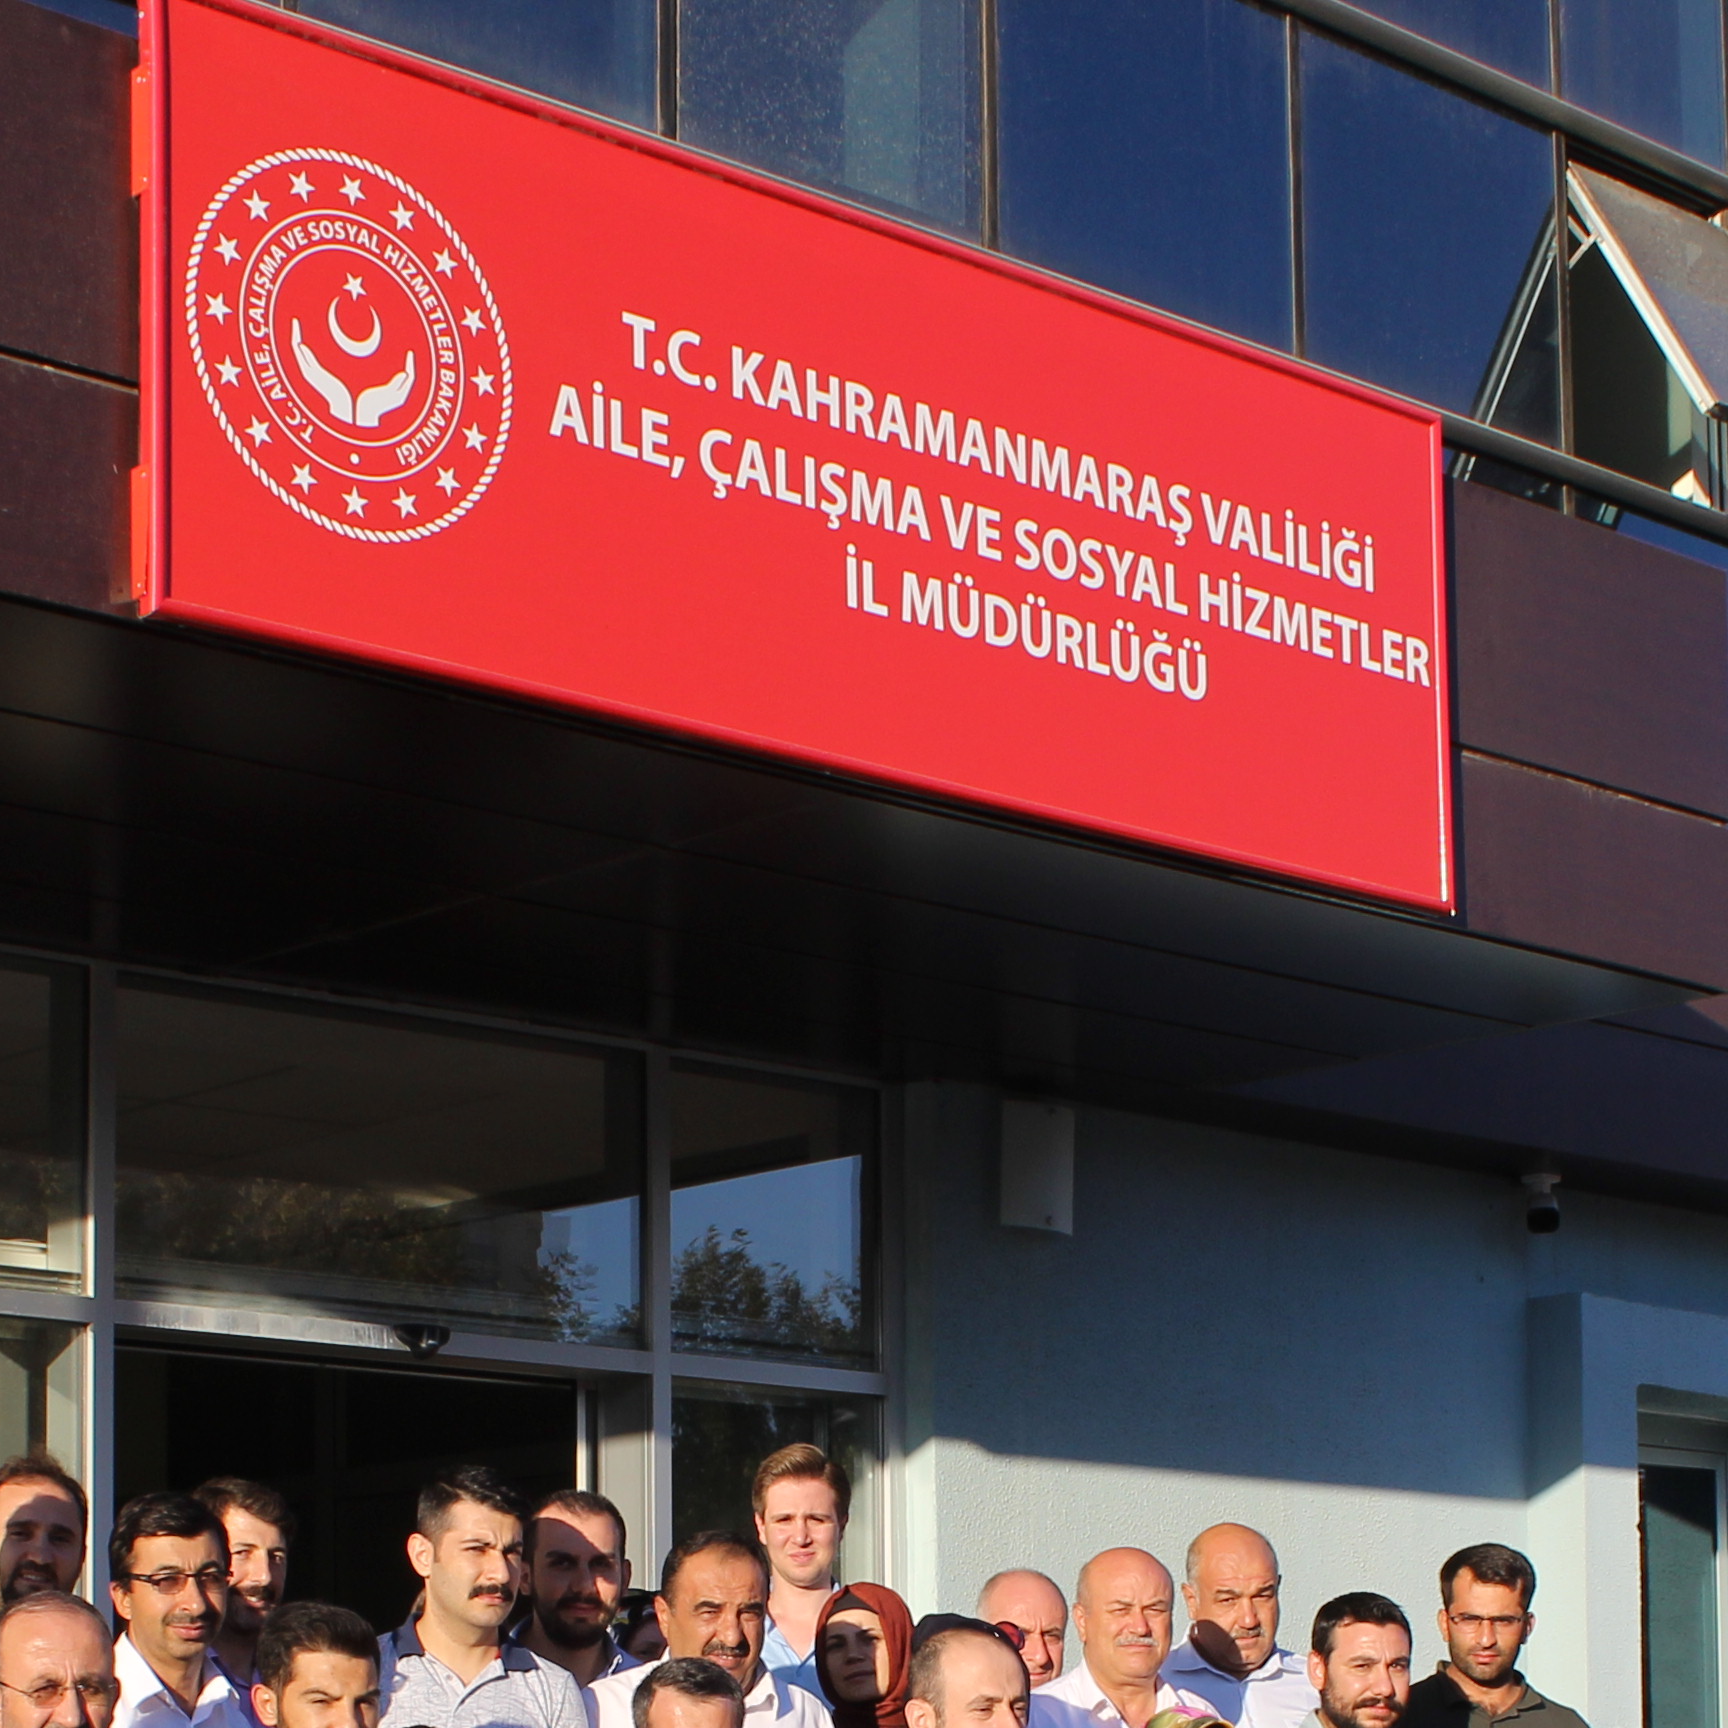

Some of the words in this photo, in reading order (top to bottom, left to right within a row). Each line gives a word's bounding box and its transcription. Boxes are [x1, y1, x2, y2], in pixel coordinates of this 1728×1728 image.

[280, 225, 309, 251] VE
[307, 219, 381, 254] SOSYAL
[248, 244, 288, 338] ÇALIŞMA
[383, 244, 455, 364] HİZMETLER
[253, 343, 288, 400] AİLE,
[395, 368, 456, 466] BAKANLIĞI
[285, 401, 314, 444] T.C.
[621, 311, 717, 392] T.C.
[731, 345, 1193, 547] KAHRAMANMARAŞ
[1200, 492, 1375, 593] VALİLİĞİ
[549, 380, 686, 479] AİLE,
[699, 428, 932, 541] ÇALIŞMA
[939, 494, 1003, 562] VE
[1014, 518, 1189, 616] SOSYAL
[1199, 571, 1431, 688] HİZMETLER
[846, 543, 889, 617] İL
[901, 570, 1207, 701] MÜDÜRLÜĞÜ
